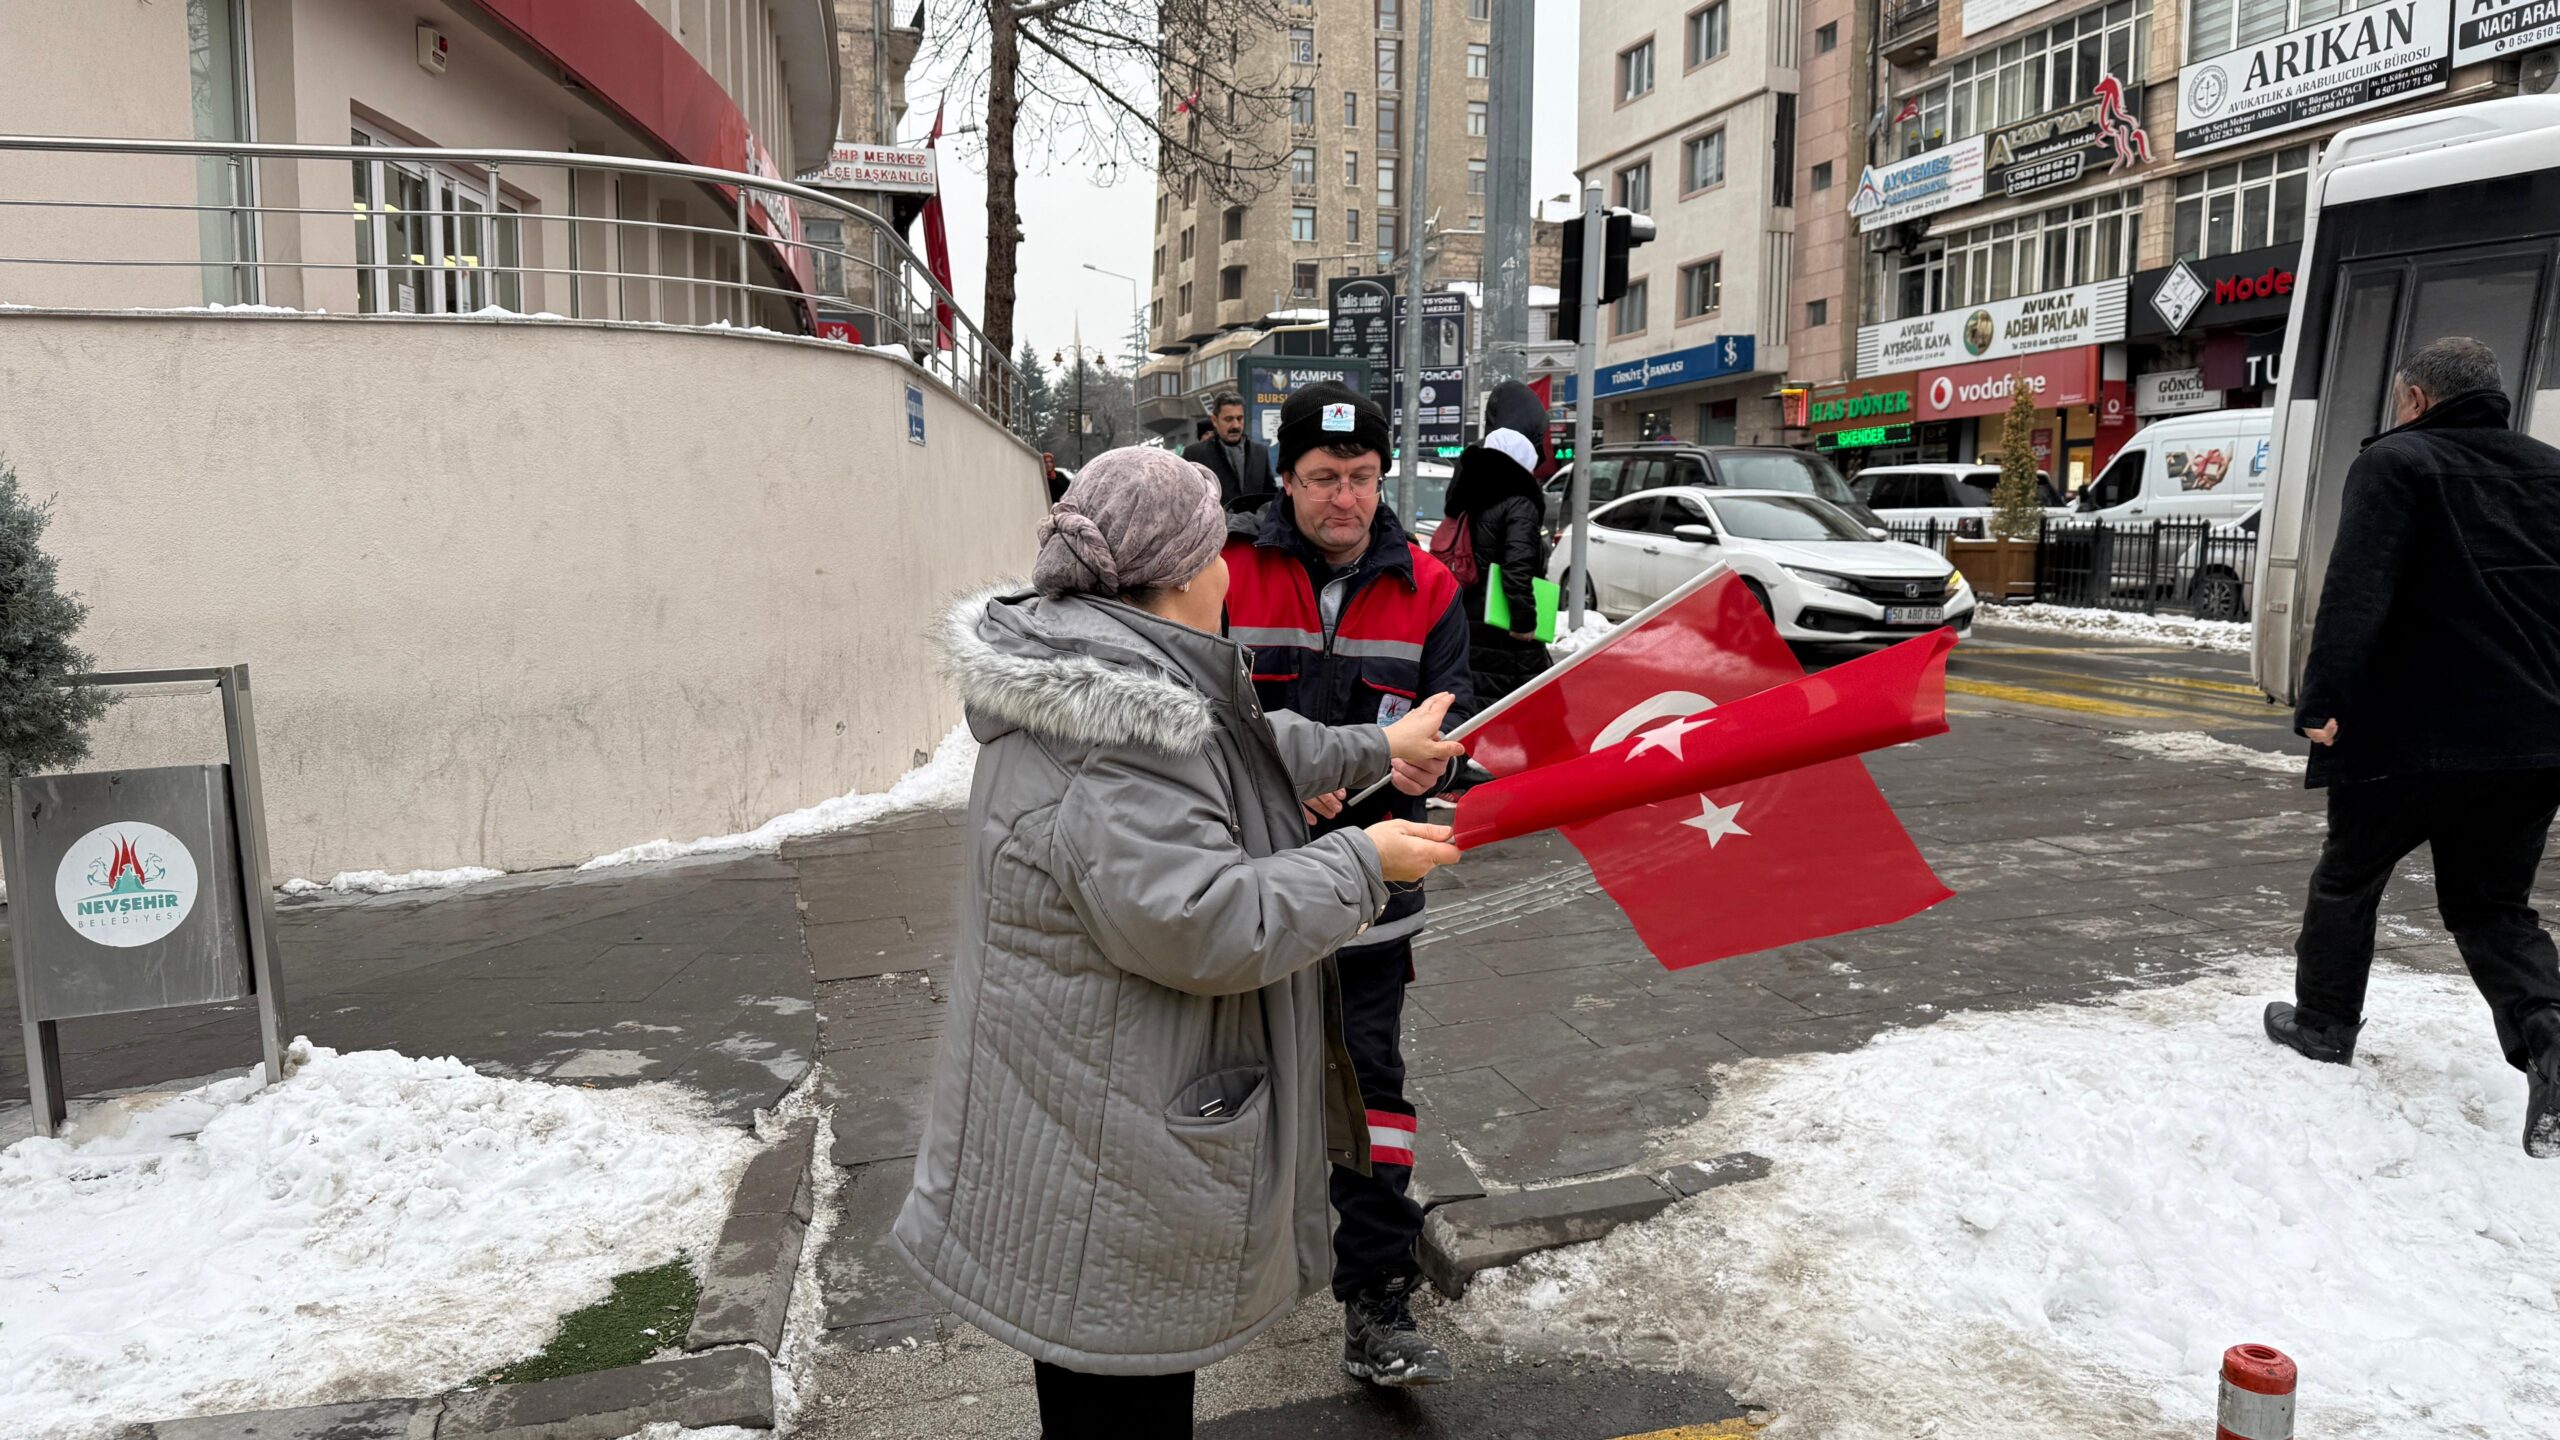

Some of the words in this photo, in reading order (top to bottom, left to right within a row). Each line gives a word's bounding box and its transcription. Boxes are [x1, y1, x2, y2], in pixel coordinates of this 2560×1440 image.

[2521, 0, 2560, 27] ARA
[2243, 1, 2416, 92] ARIKAN
[2509, 37, 2515, 48] 0
[2517, 31, 2534, 46] 532
[2536, 26, 2553, 40] 610
[2228, 89, 2284, 114] AVUKATLIK
[2285, 87, 2293, 97] &
[2295, 60, 2382, 95] ARABULUCULUK
[2384, 46, 2431, 69] BÜROSU
[2409, 62, 2438, 77] ARIKAN
[2330, 83, 2363, 100] ÇAPACI
[2382, 84, 2395, 95] 507
[2397, 81, 2411, 91] 717
[2412, 77, 2421, 87] 71
[2423, 74, 2433, 84] 50
[2230, 113, 2255, 126] Mehmet
[2257, 104, 2287, 120] ARIKAN
[2308, 105, 2321, 116] 507
[864, 151, 926, 165] MERKEZ
[855, 167, 933, 184] BAŞKANLIĞI
[1883, 154, 1951, 193] AYKEMEZ
[2215, 266, 2297, 304] Mode
[2022, 293, 2074, 315] AVUKAT
[1900, 321, 1934, 338] AVUKAT
[2004, 315, 2039, 339] ADEM
[2041, 307, 2089, 333] PAYLAN
[1883, 337, 1923, 357] AYŞEGÜL
[1925, 333, 1951, 350] KAYA
[1612, 368, 1642, 385] TÜRKİYE
[1650, 361, 1684, 377] BANKASI
[1257, 393, 1288, 404] BURS
[1812, 398, 1845, 422] HAS
[1848, 390, 1909, 418] DÖNER
[1893, 608, 1903, 620] 50
[1926, 608, 1942, 620] 623
